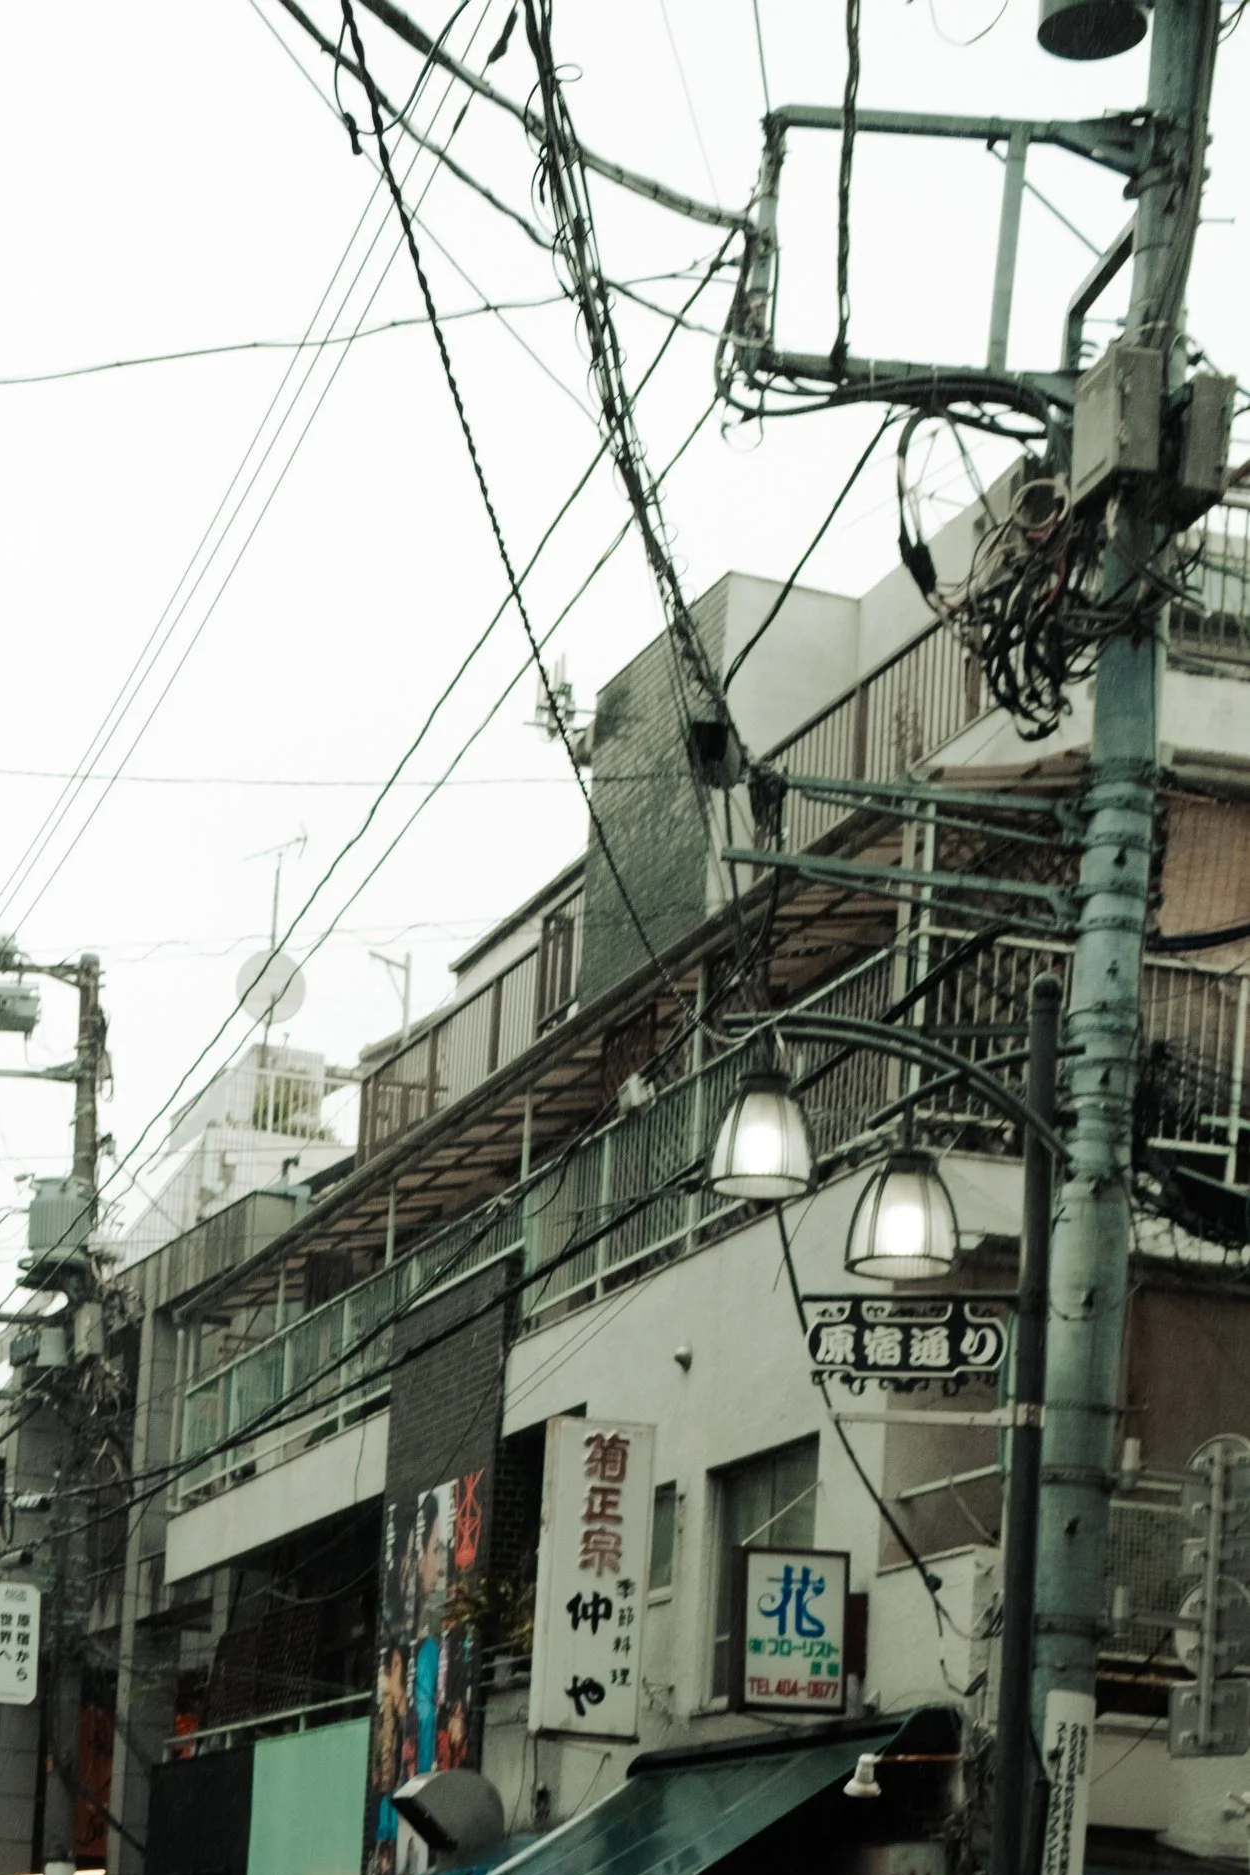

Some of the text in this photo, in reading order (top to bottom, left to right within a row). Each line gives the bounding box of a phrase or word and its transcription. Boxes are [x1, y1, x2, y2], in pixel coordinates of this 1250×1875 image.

[816, 1324, 998, 1368] 原宿通り
[578, 1432, 631, 1577] 菊正宗
[609, 1578, 636, 1688] 季節料理
[758, 1563, 827, 1638] 花
